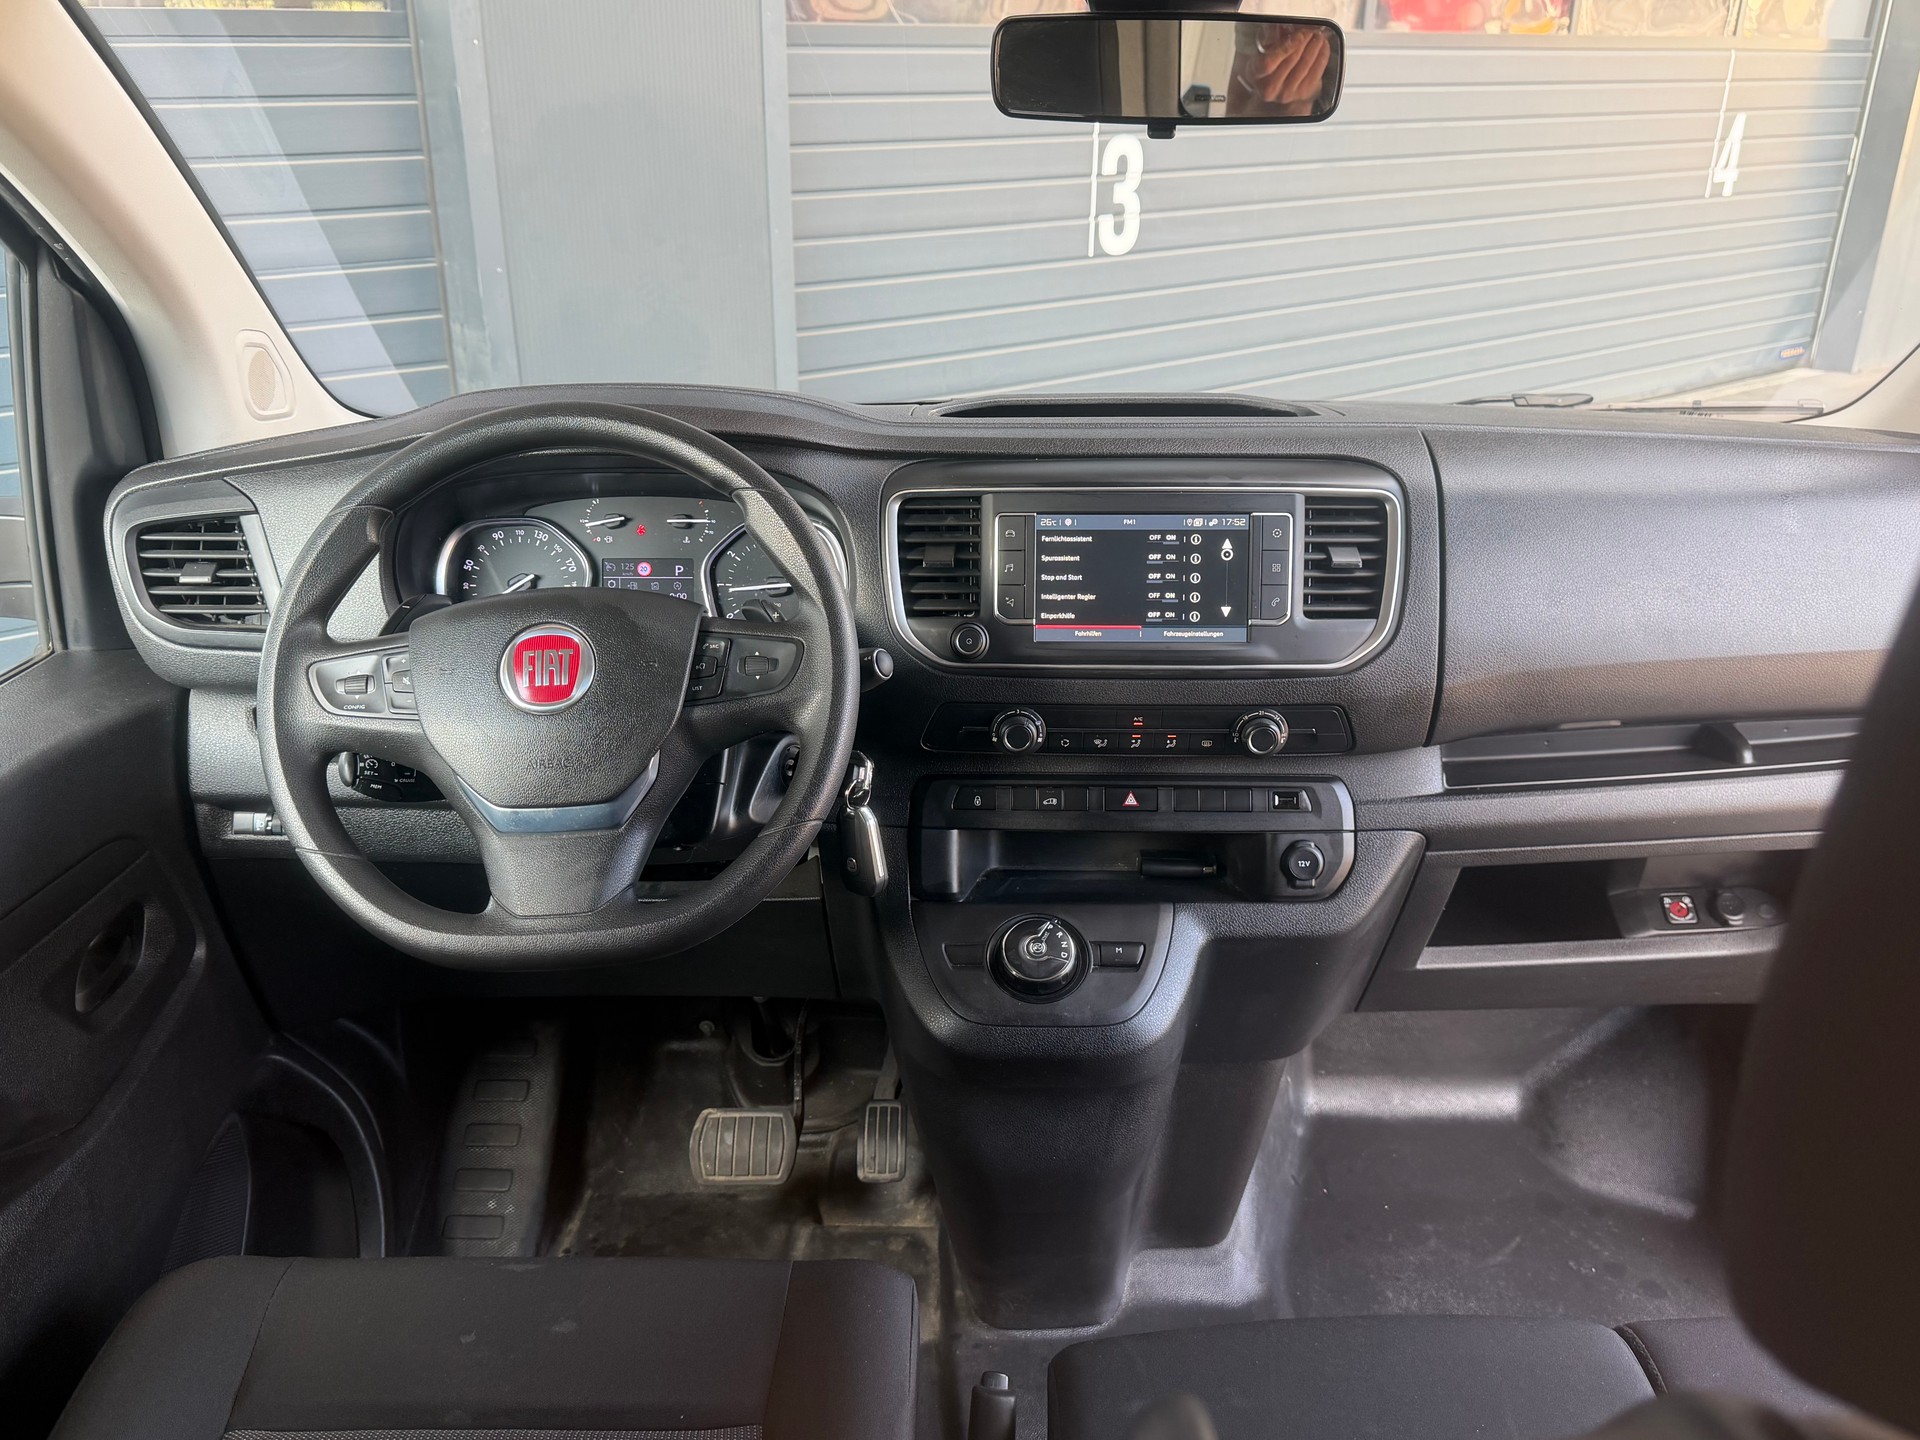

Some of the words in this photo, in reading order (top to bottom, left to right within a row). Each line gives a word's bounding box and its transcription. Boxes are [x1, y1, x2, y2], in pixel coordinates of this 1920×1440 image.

[1712, 112, 1747, 197] 4
[1098, 133, 1144, 256] 3
[1221, 518, 1246, 526] 17:52
[492, 530, 504, 540] 90
[534, 530, 549, 542] 130
[477, 544, 485, 552] 70
[553, 543, 563, 553] 150
[727, 550, 736, 558] 2
[1041, 554, 1080, 562] Spurassistent
[463, 559, 474, 571] 50
[565, 557, 577, 573] 170
[620, 562, 635, 571] 125
[675, 565, 684, 576] P
[1040, 593, 1076, 601] Intelligenter
[1077, 593, 1097, 601] Regler
[1040, 612, 1075, 620] Einparkhilfe
[1163, 630, 1224, 638] Fahrzeugeinstellungen
[522, 648, 574, 688] FIAT
[526, 758, 574, 769] AIRBAG
